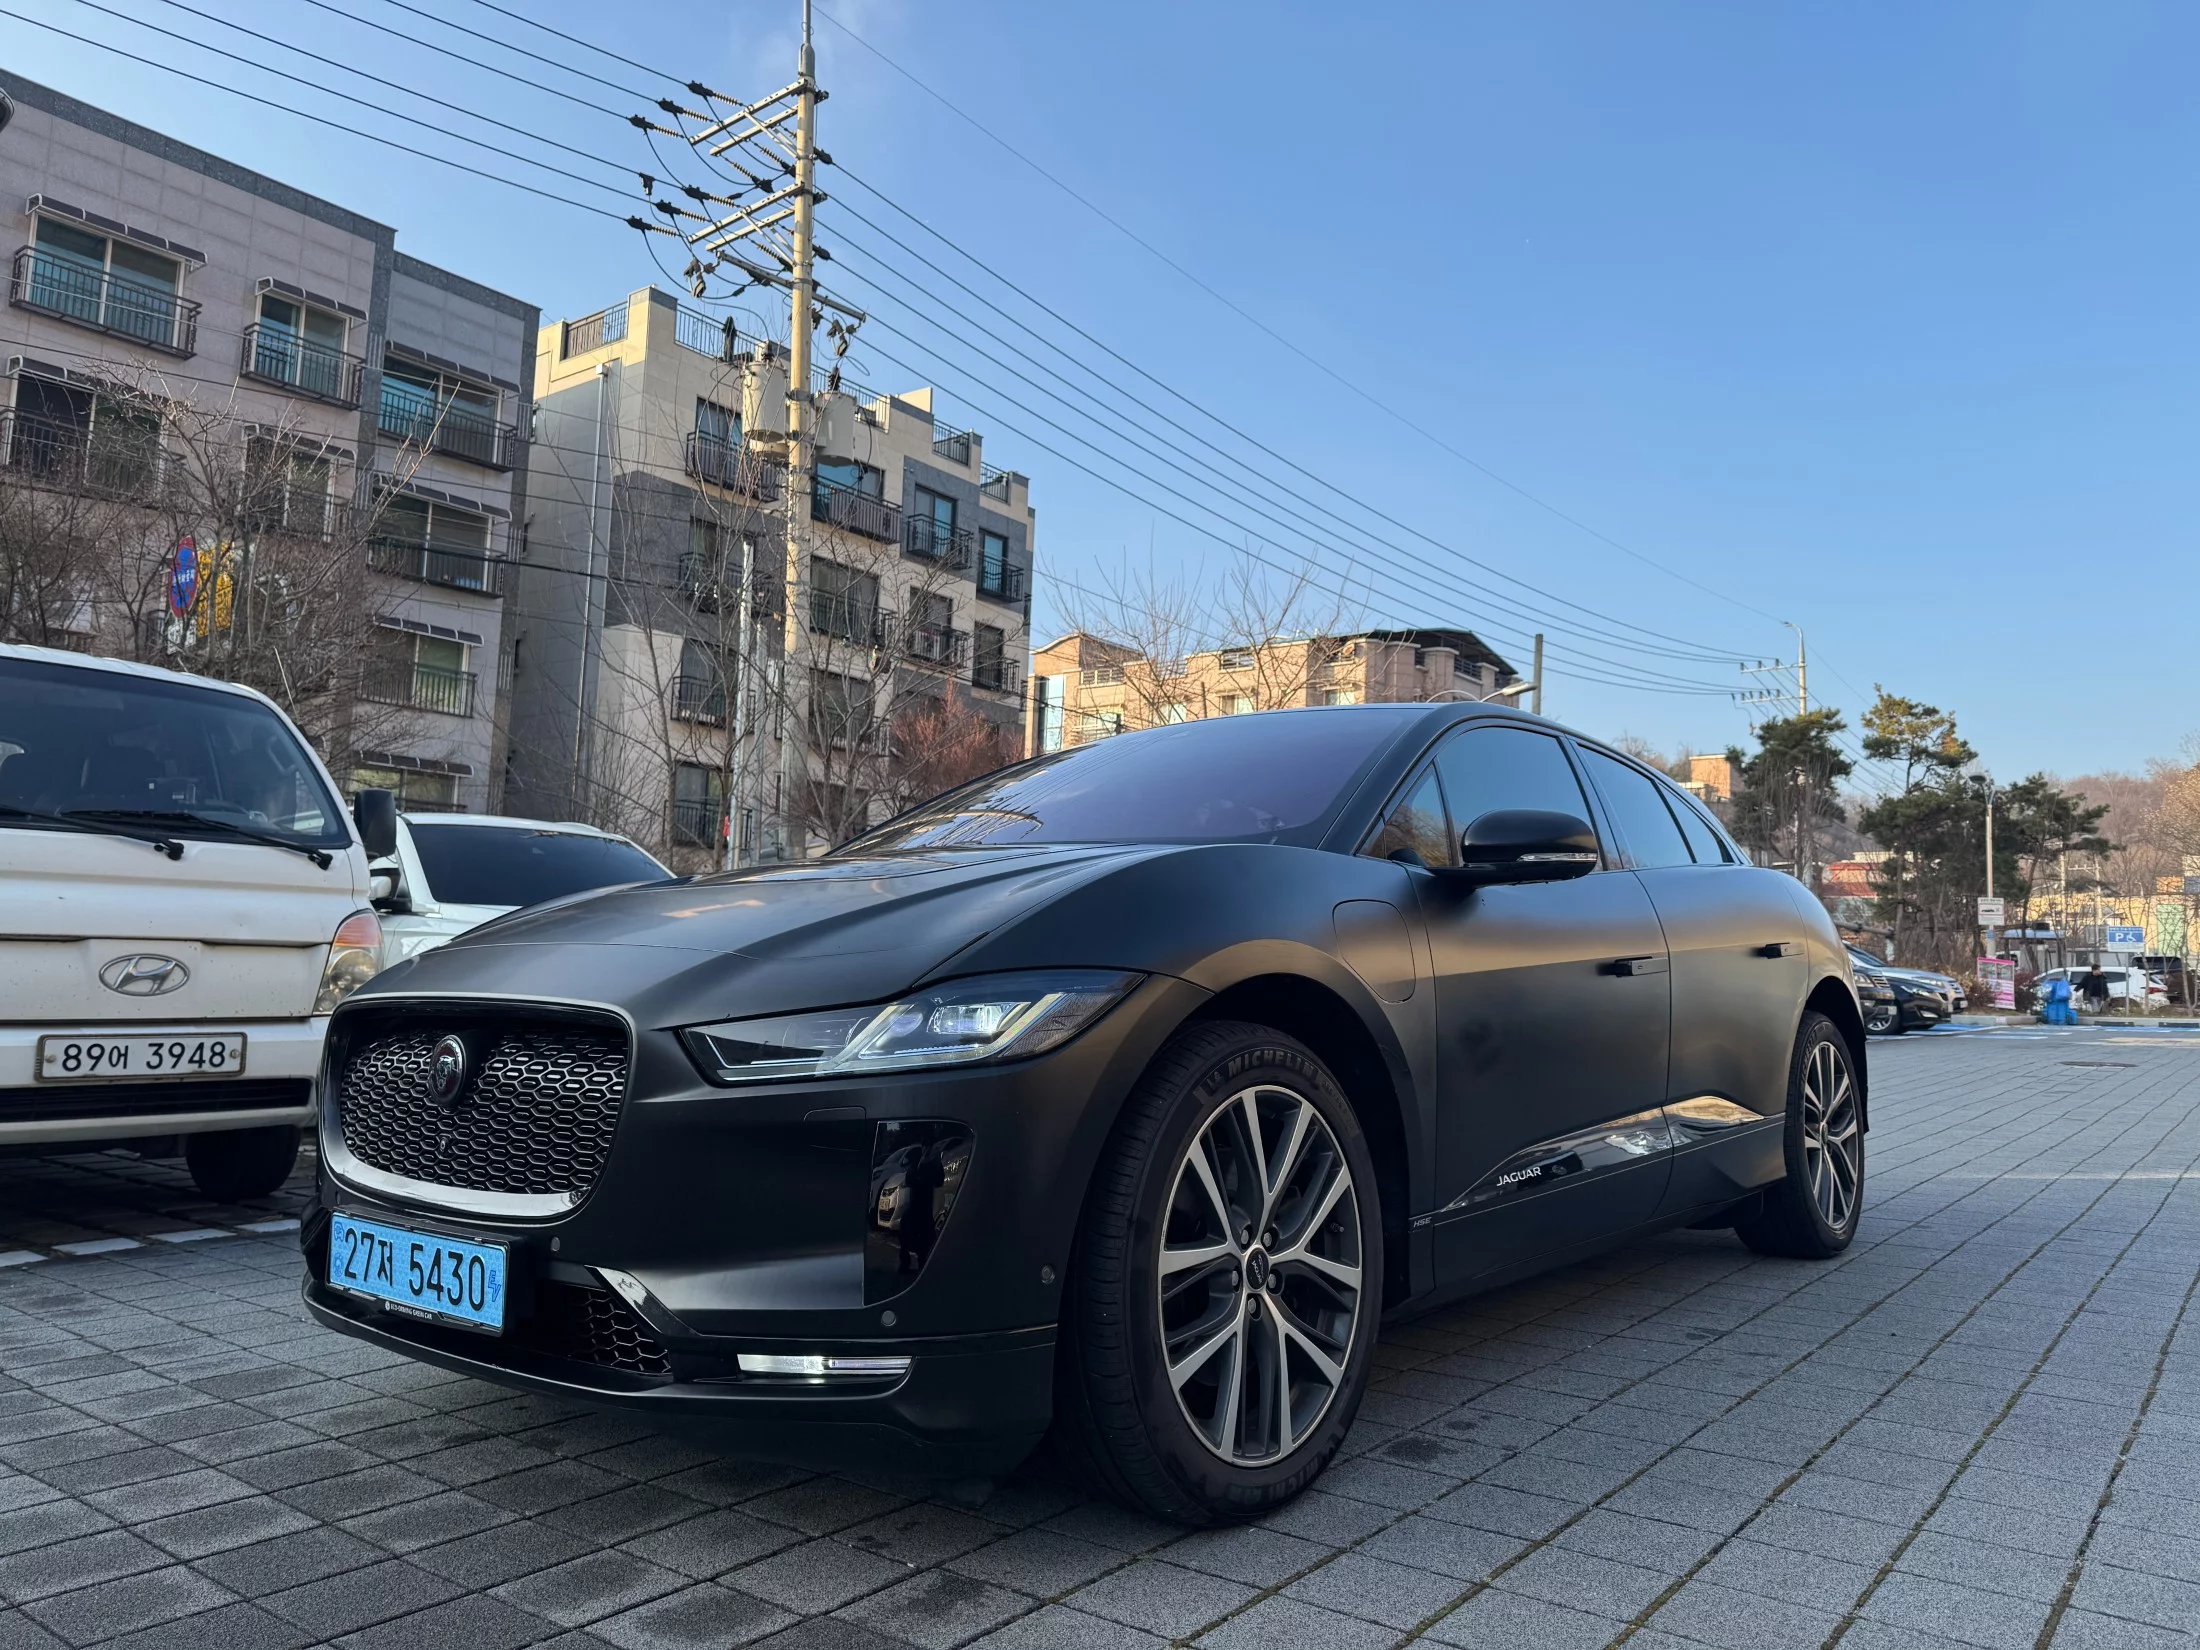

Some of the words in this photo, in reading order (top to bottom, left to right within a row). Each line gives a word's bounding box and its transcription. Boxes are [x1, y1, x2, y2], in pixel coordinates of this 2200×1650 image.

[2115, 932, 2124, 942] P
[62, 1043, 129, 1072] 89어
[146, 1041, 226, 1069] 3948
[1227, 1049, 1317, 1079] MICHELIN
[1496, 1166, 1542, 1187] JAGUAR
[1413, 1216, 1433, 1228] HSE
[344, 1227, 393, 1287] 27저
[409, 1242, 485, 1312] 5430
[487, 1270, 502, 1303] EV
